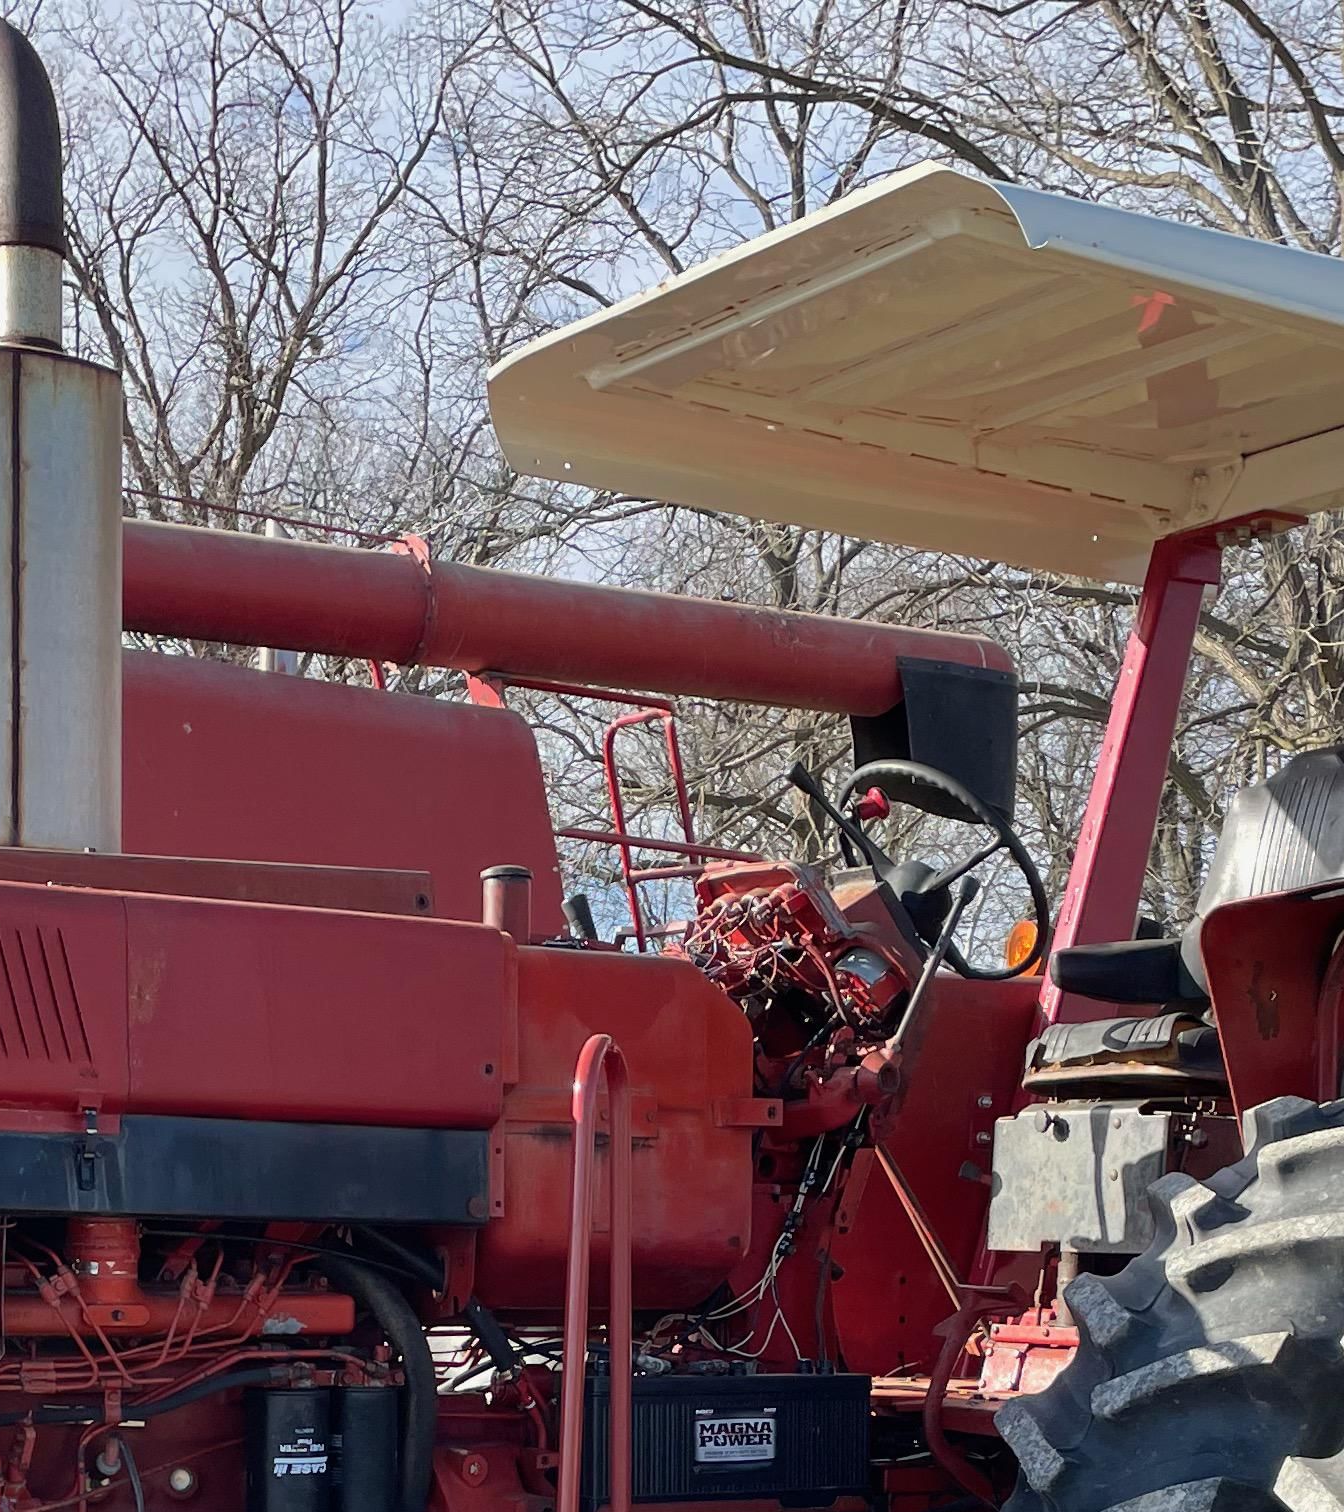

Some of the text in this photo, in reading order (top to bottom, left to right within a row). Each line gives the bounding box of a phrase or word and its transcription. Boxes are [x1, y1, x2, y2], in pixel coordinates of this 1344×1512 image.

[699, 1421, 773, 1435] MAGNA
[699, 1433, 773, 1447] POWER
[290, 1463, 327, 1475] CASE
